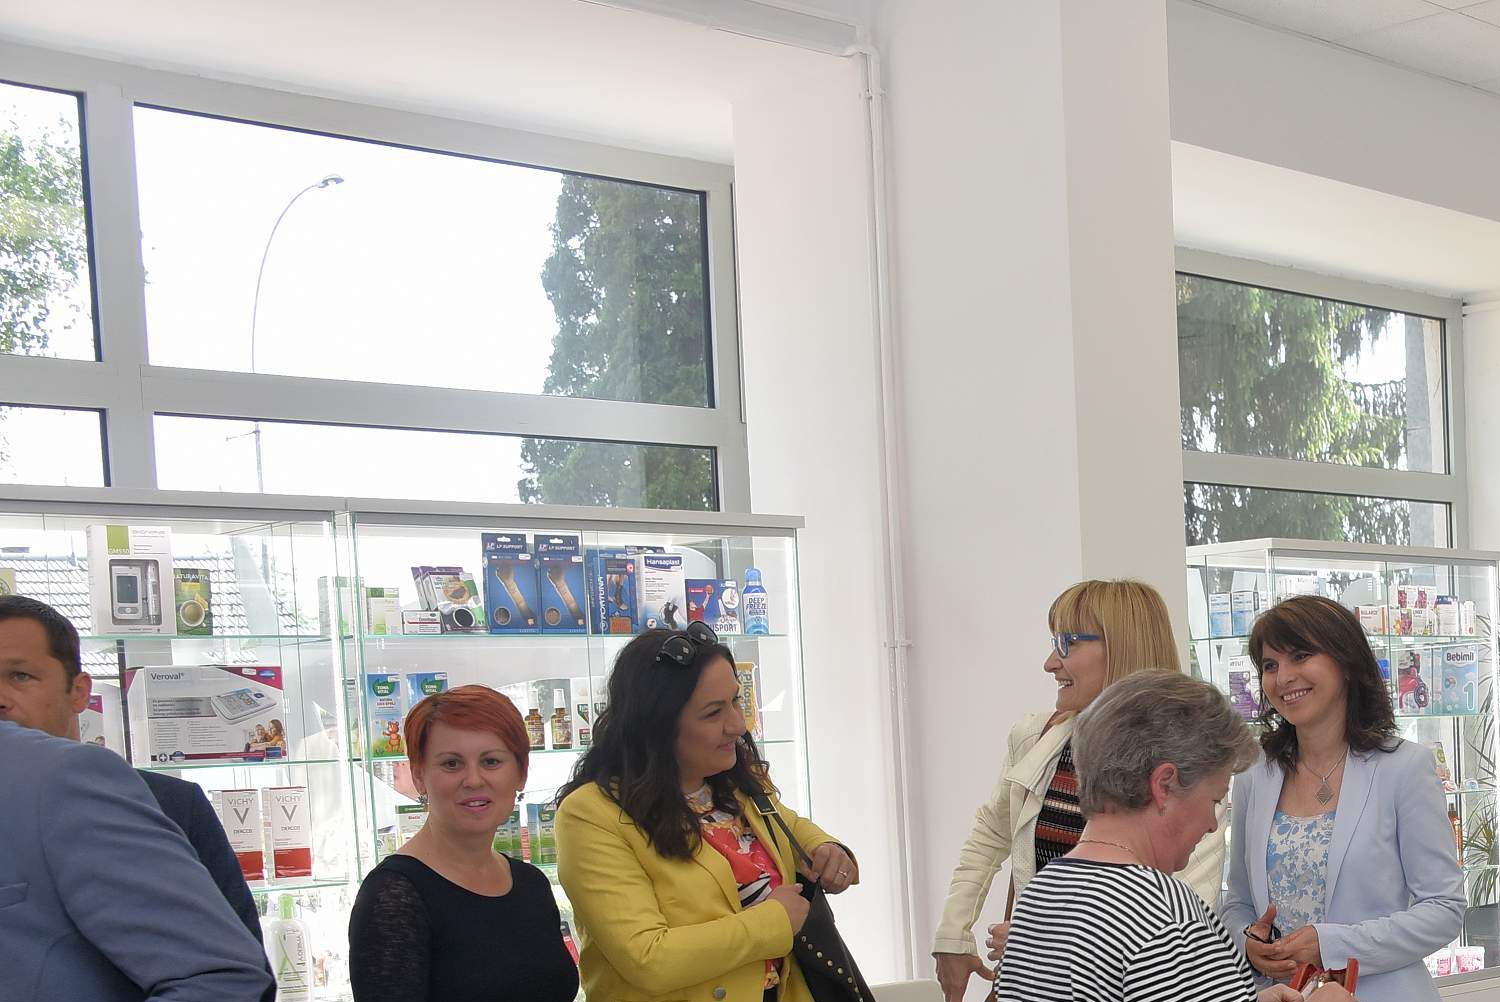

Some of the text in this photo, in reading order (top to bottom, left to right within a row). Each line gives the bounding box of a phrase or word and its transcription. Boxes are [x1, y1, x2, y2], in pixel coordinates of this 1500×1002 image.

[1446, 652, 1474, 662] Bebimil
[151, 672, 181, 681] Veroval
[1463, 681, 1475, 711] 1
[275, 795, 301, 803] VICHY
